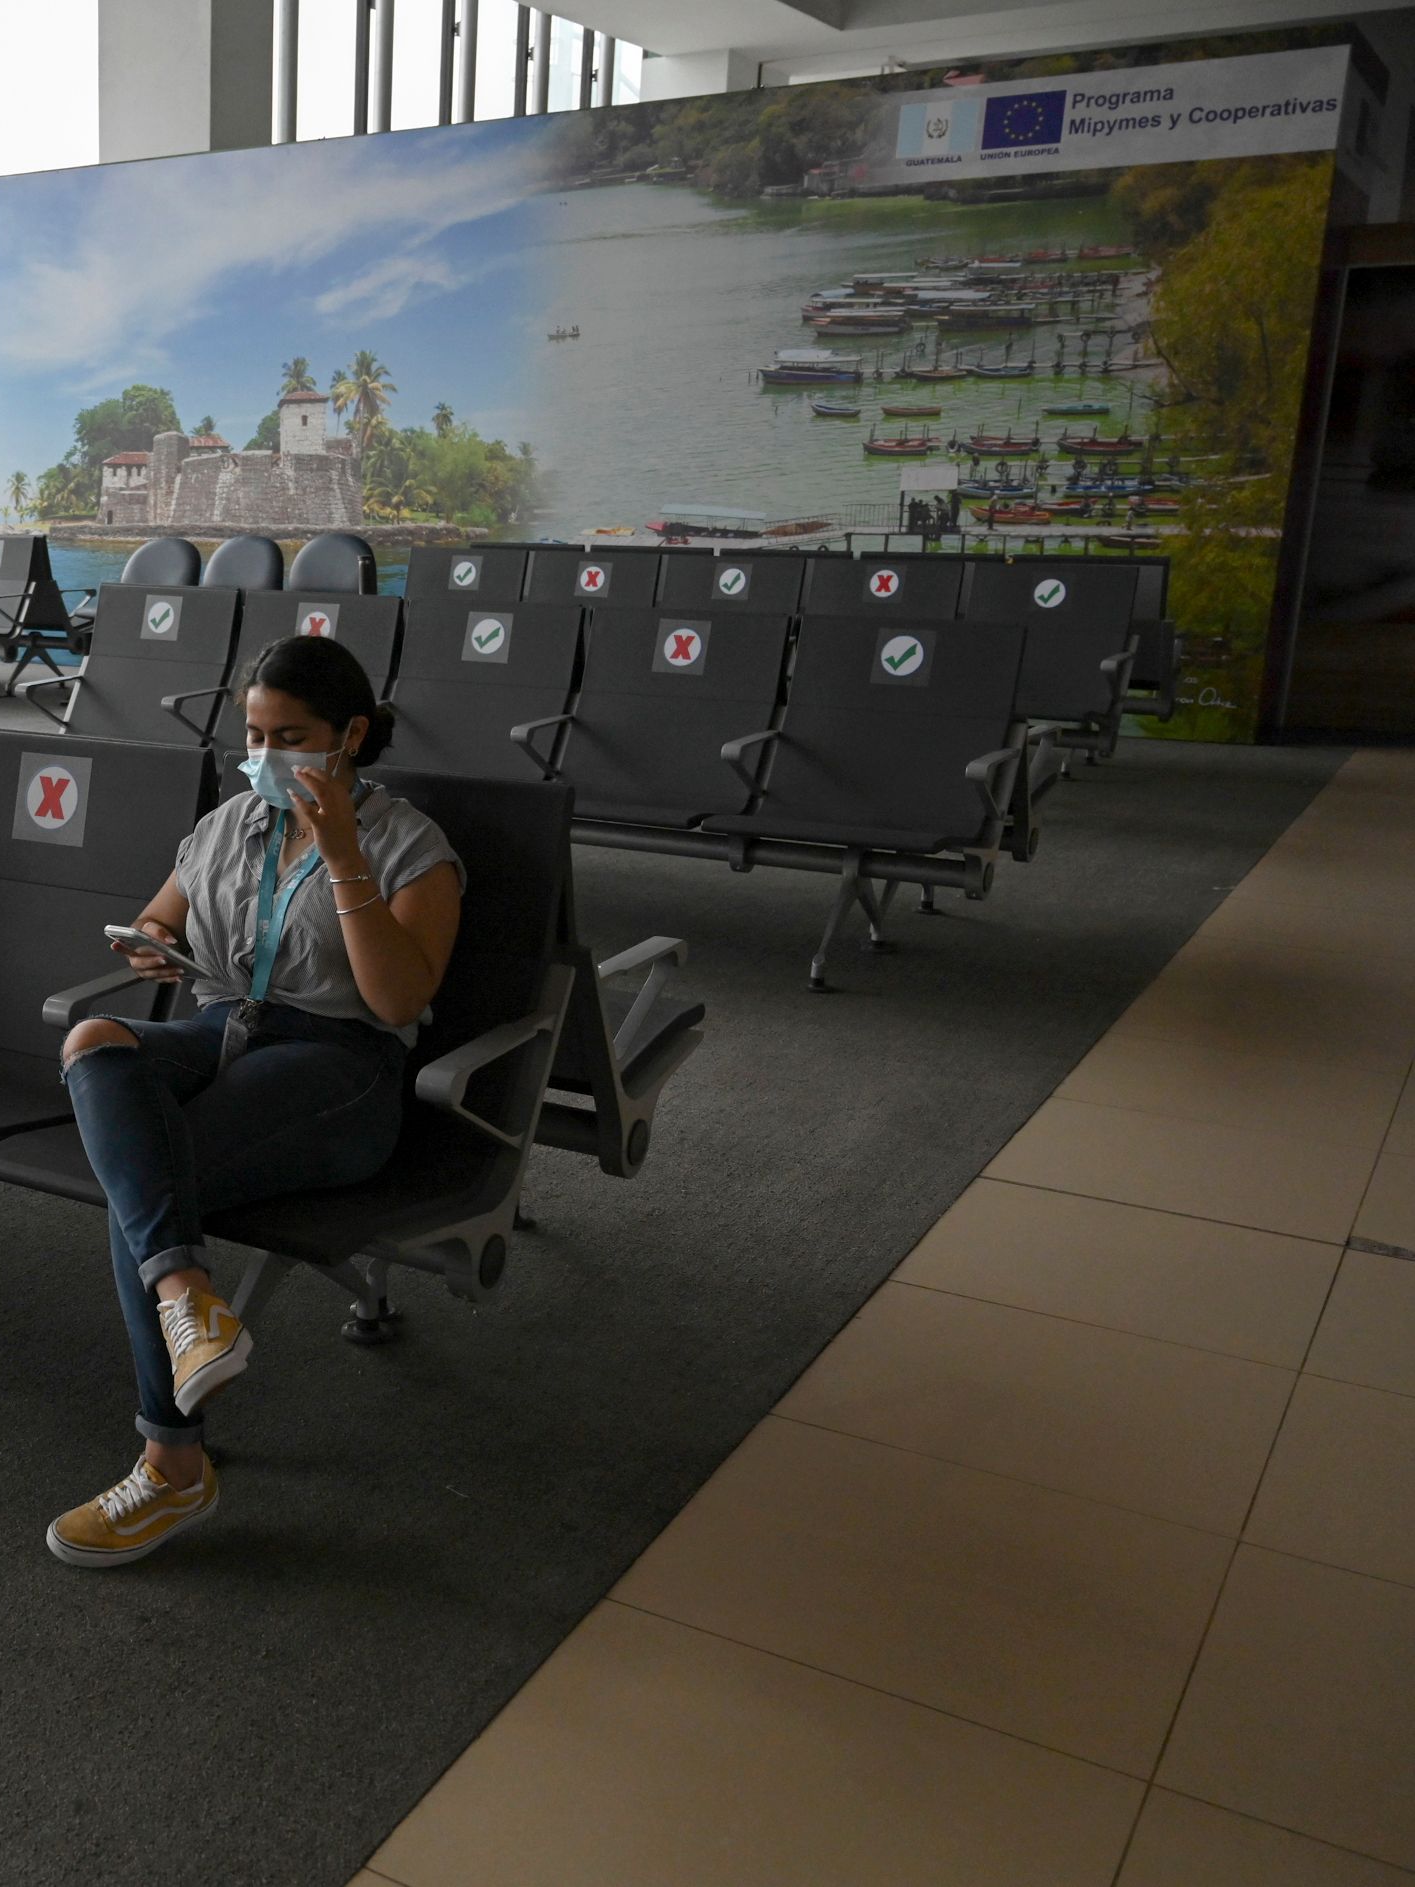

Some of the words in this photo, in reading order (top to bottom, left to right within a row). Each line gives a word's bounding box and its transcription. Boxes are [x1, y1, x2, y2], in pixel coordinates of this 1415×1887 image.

[1071, 88, 1175, 110] Programa
[1068, 113, 1162, 137] Mipymes
[1168, 112, 1182, 130] y
[1188, 98, 1338, 124] Cooperativas
[906, 155, 963, 167] GUATEMALA
[1014, 147, 1060, 159] EUROPEA
